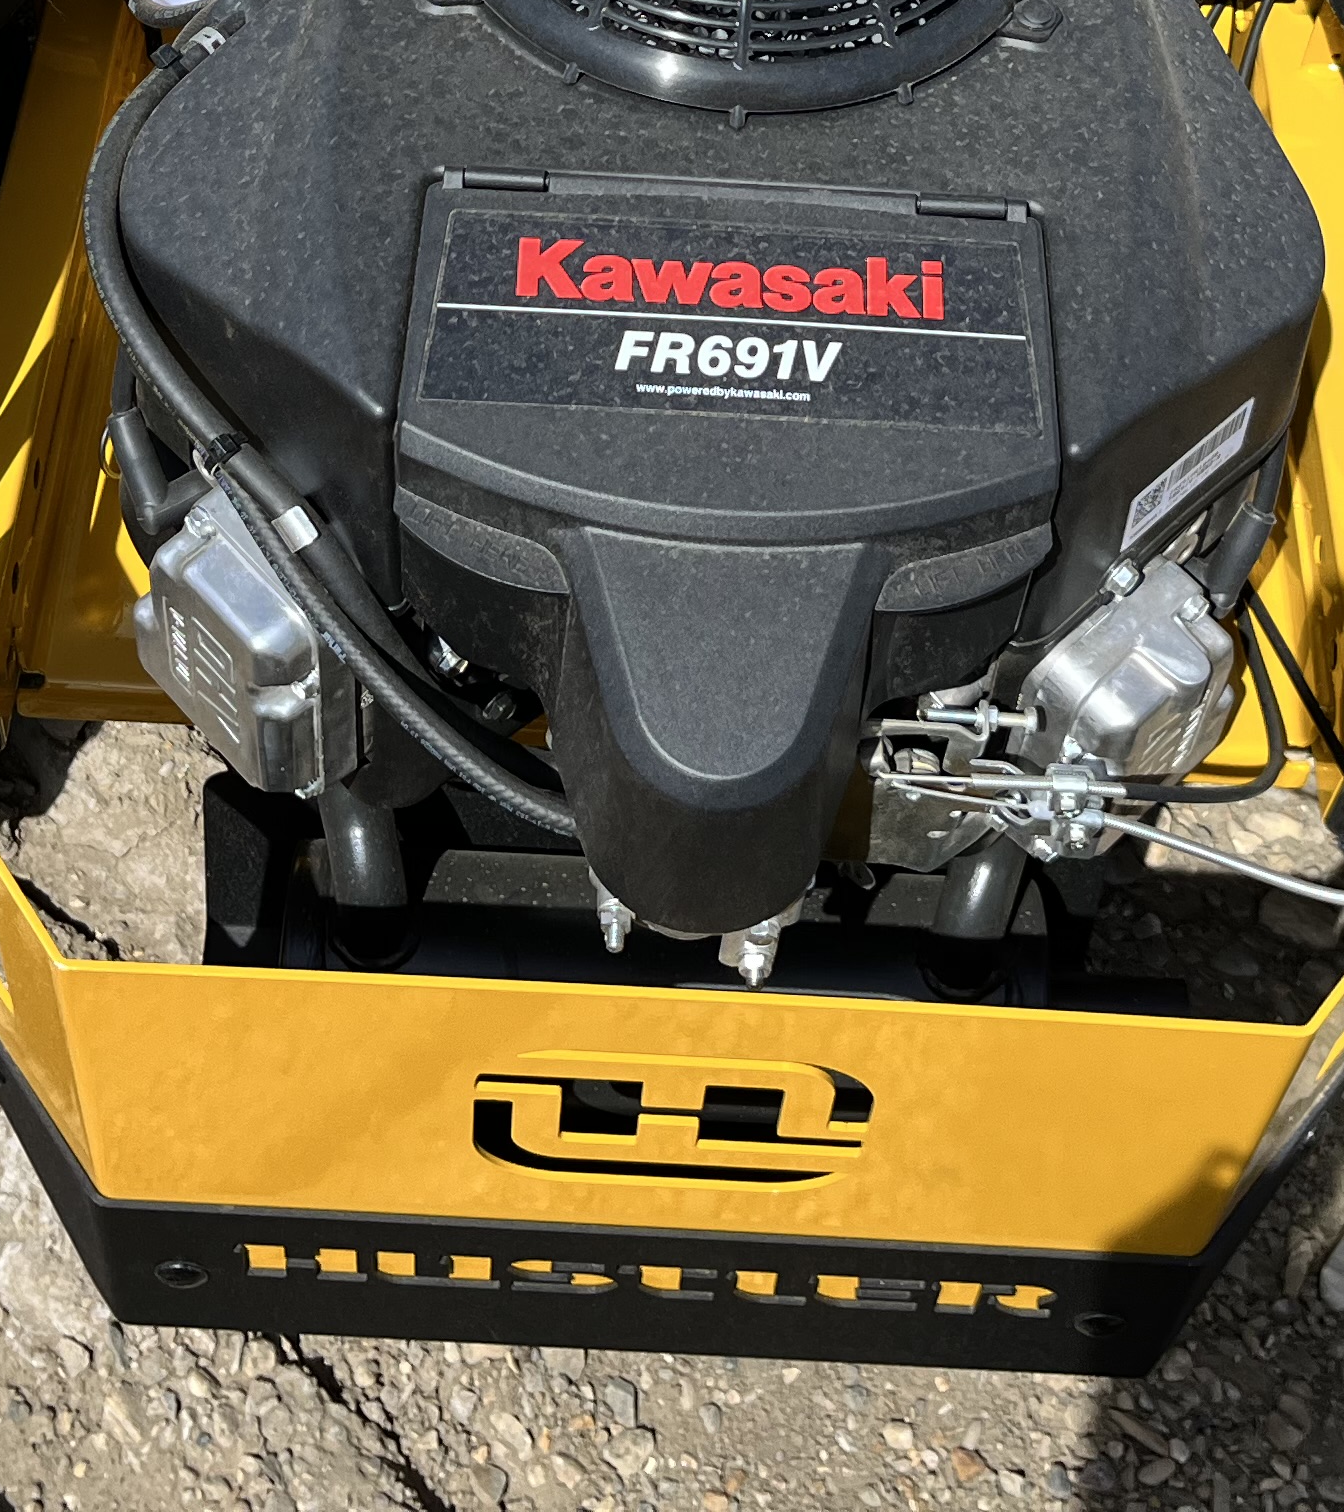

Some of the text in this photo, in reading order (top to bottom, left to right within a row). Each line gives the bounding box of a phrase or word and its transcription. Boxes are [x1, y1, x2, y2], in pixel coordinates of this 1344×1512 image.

[514, 236, 945, 321] Kawasaki
[614, 329, 844, 383] FR691V
[635, 382, 811, 402] www.poweredbykawasaki.com
[233, 1243, 1057, 1319] HUSTLER
